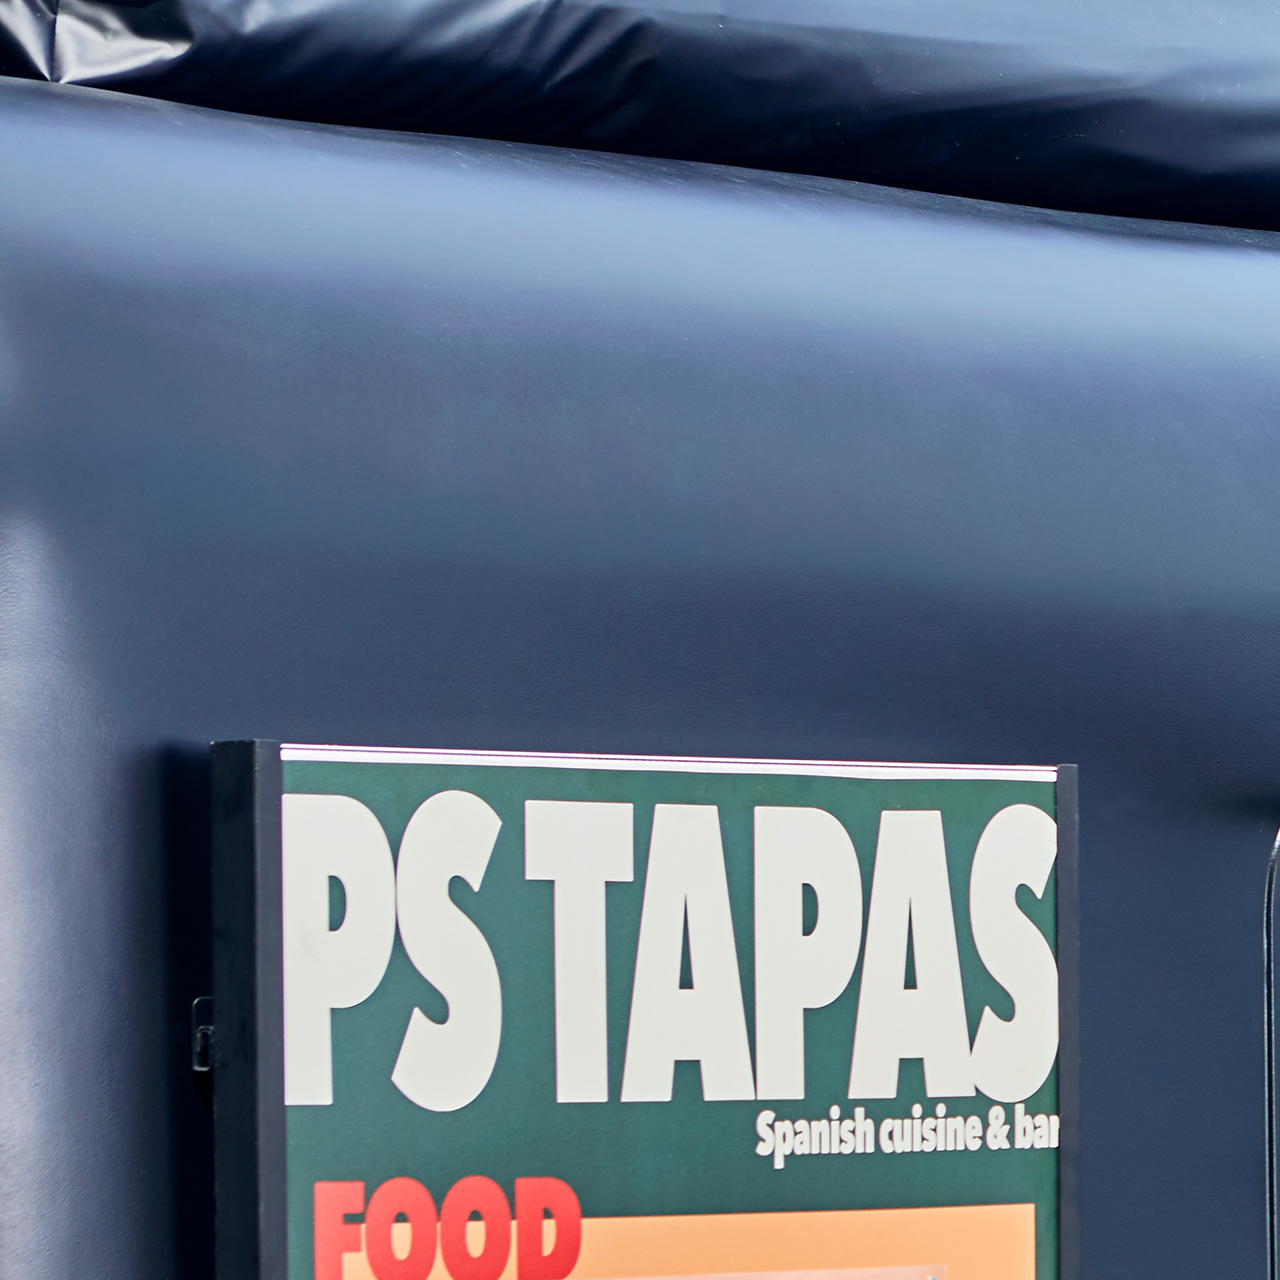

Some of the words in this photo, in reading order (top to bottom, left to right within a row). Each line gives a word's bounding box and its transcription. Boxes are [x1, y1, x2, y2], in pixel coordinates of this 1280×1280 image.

[281, 789, 503, 1113] PS
[524, 799, 1060, 1106] TAPAS
[755, 1105, 876, 1170] Spanish
[879, 1102, 983, 1154] cuisine
[985, 1104, 1011, 1151] &
[1014, 1103, 1060, 1150] bar
